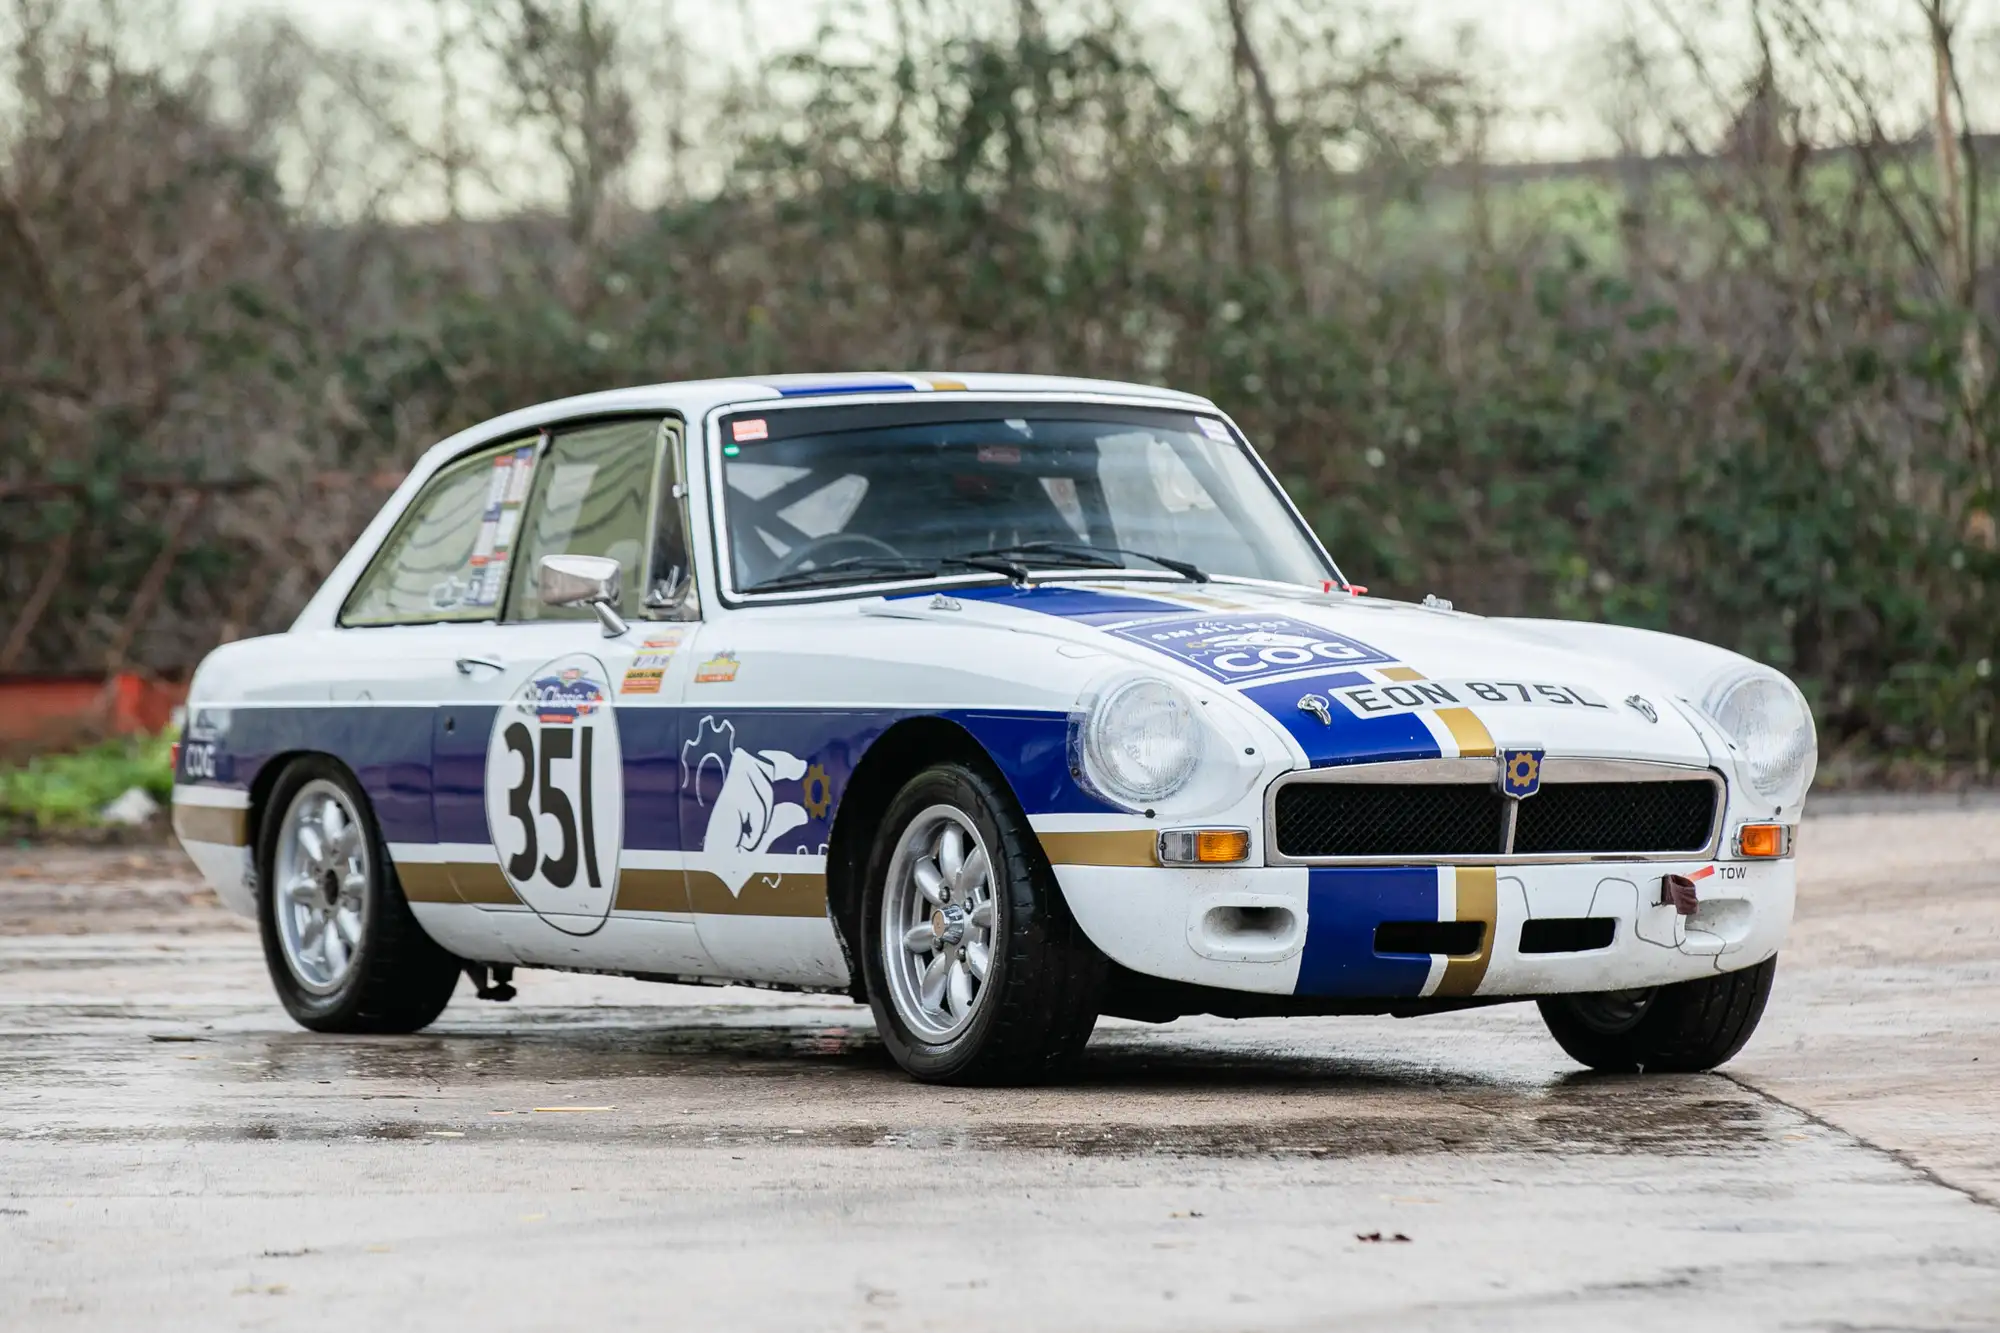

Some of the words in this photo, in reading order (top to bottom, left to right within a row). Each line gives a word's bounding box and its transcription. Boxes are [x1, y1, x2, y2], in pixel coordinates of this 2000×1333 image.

[1151, 620, 1290, 640] SMALLEST
[1212, 641, 1368, 673] COG
[1345, 681, 1461, 712] EON
[1464, 682, 1609, 709] 875L
[503, 721, 603, 889] 351
[1719, 866, 1747, 880] TOW
